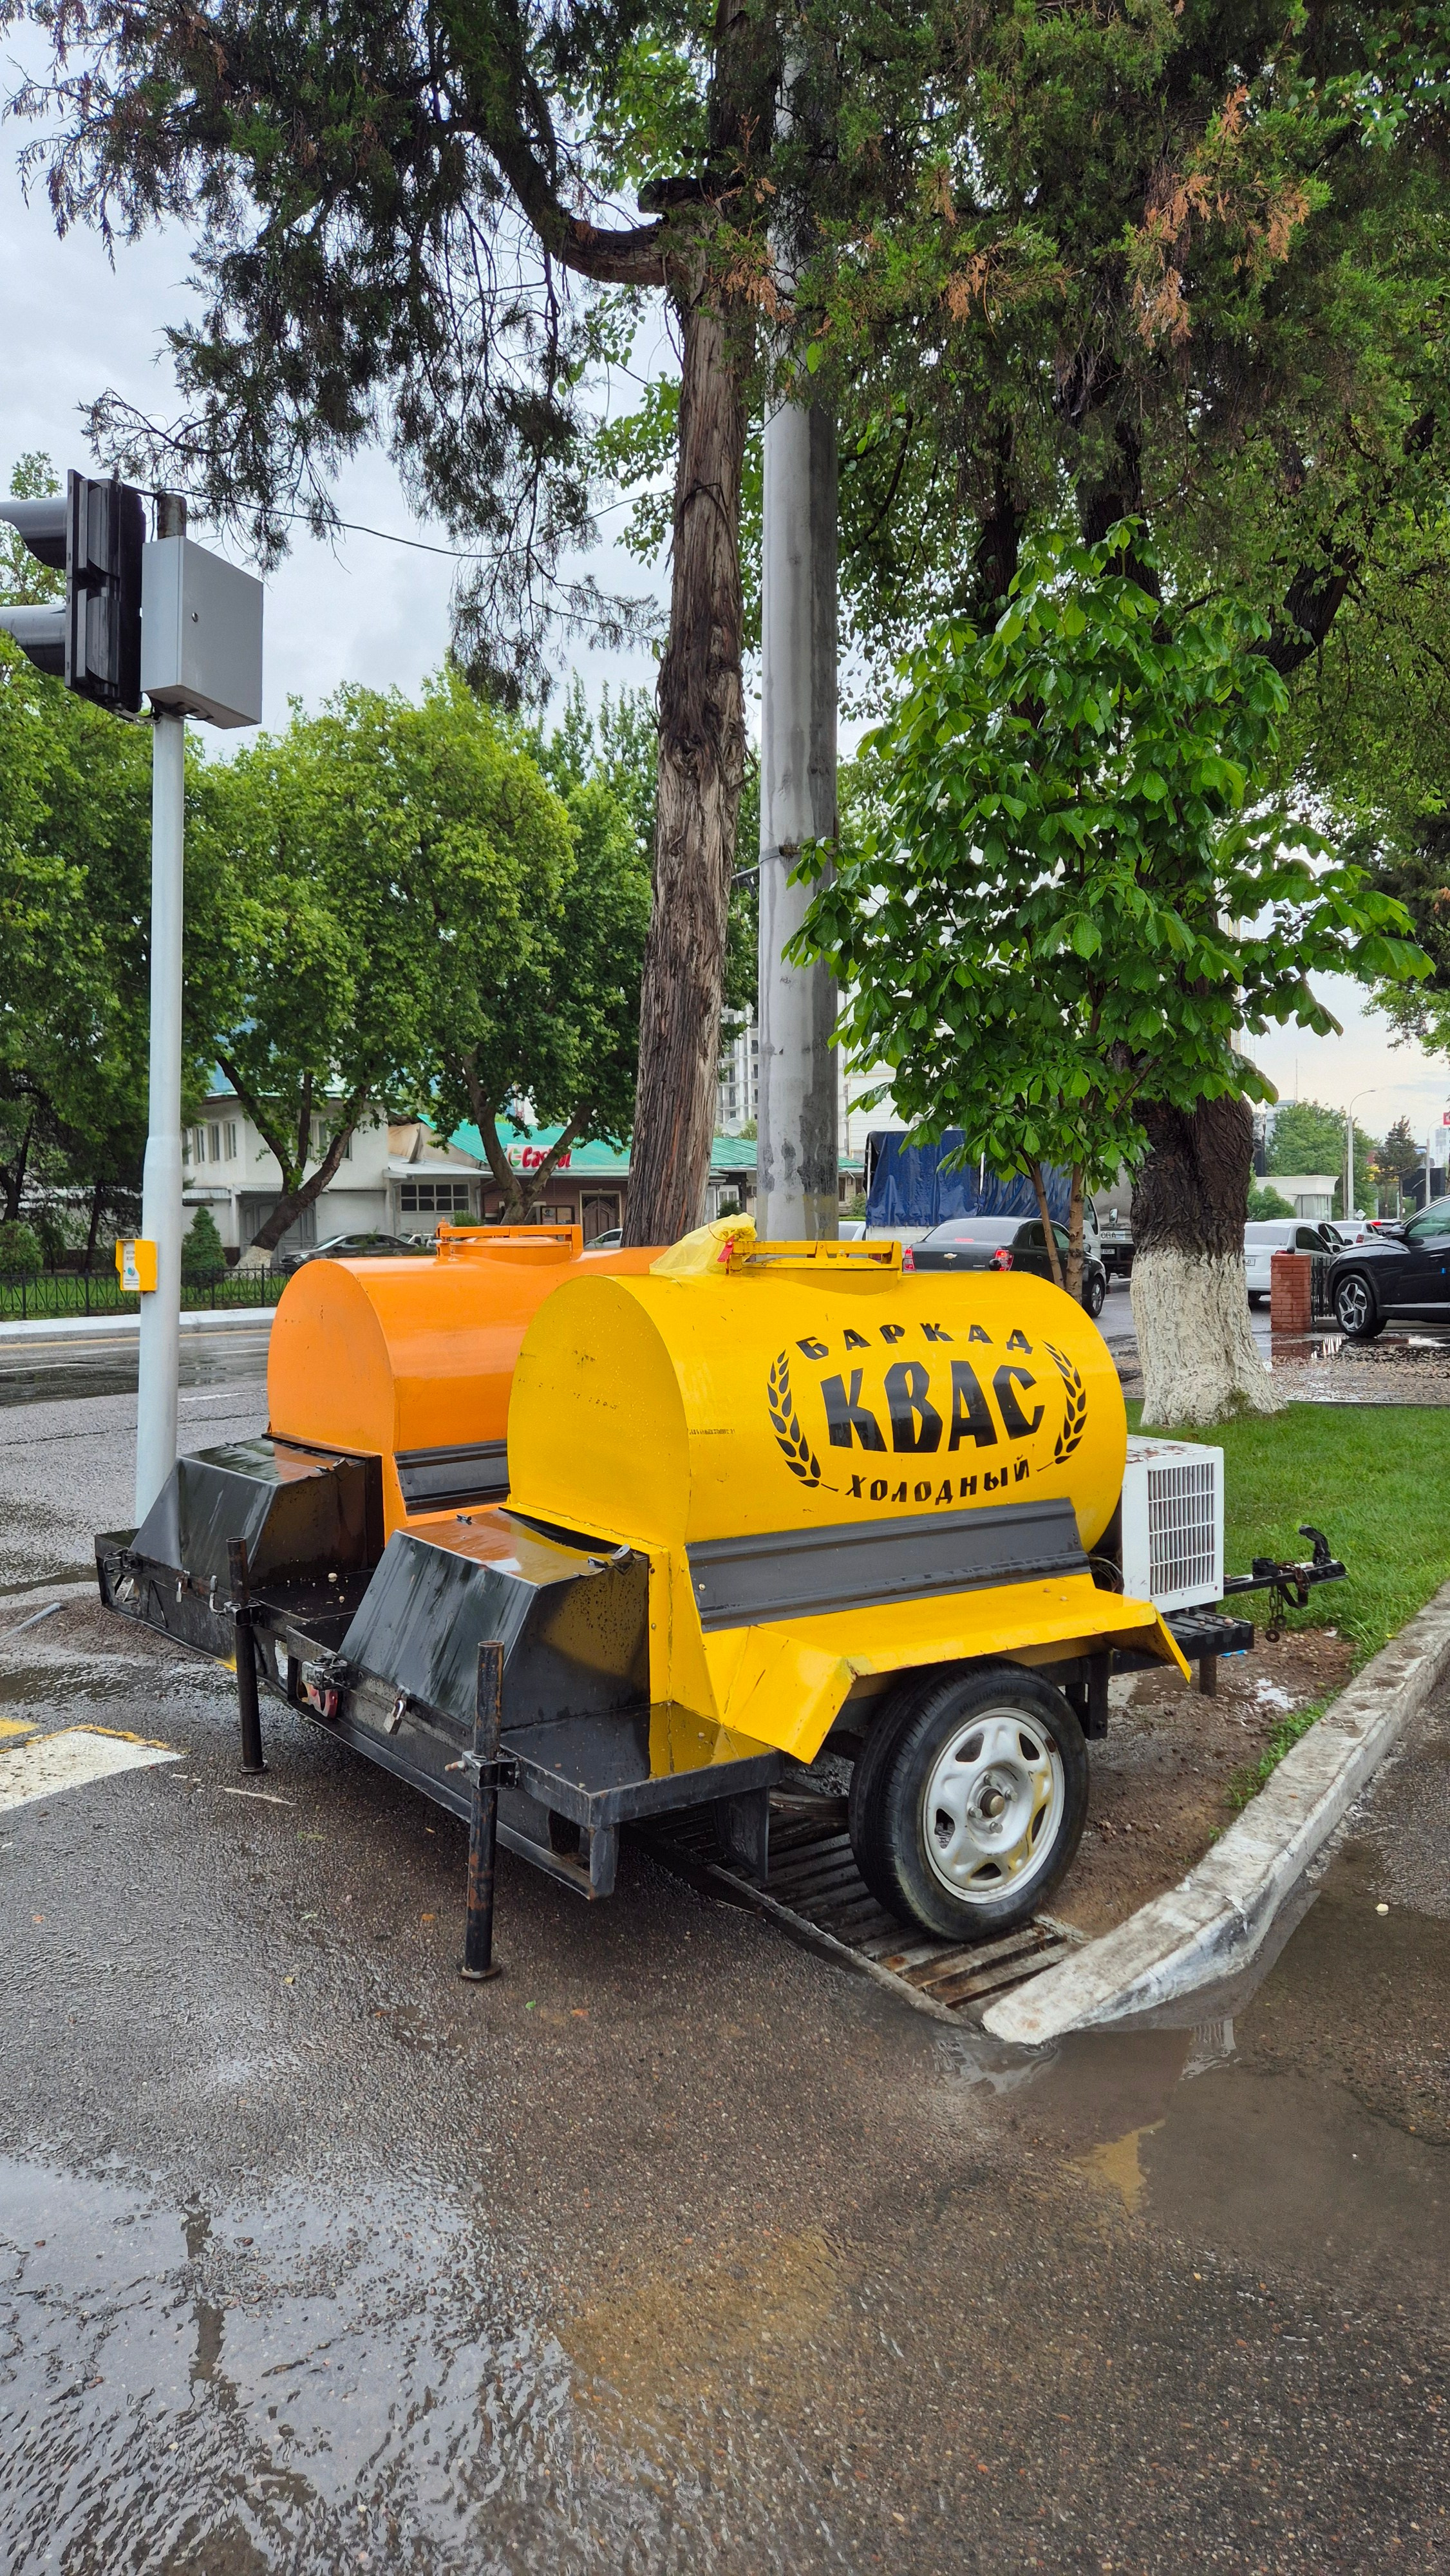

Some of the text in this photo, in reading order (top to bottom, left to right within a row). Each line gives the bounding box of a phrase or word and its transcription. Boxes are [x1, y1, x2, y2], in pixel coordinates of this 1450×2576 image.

[796, 1323, 1033, 1360] БАРКАД
[820, 1360, 1045, 1454] КВАС
[845, 1454, 1030, 1505] ХОЛОДНЫЙ
